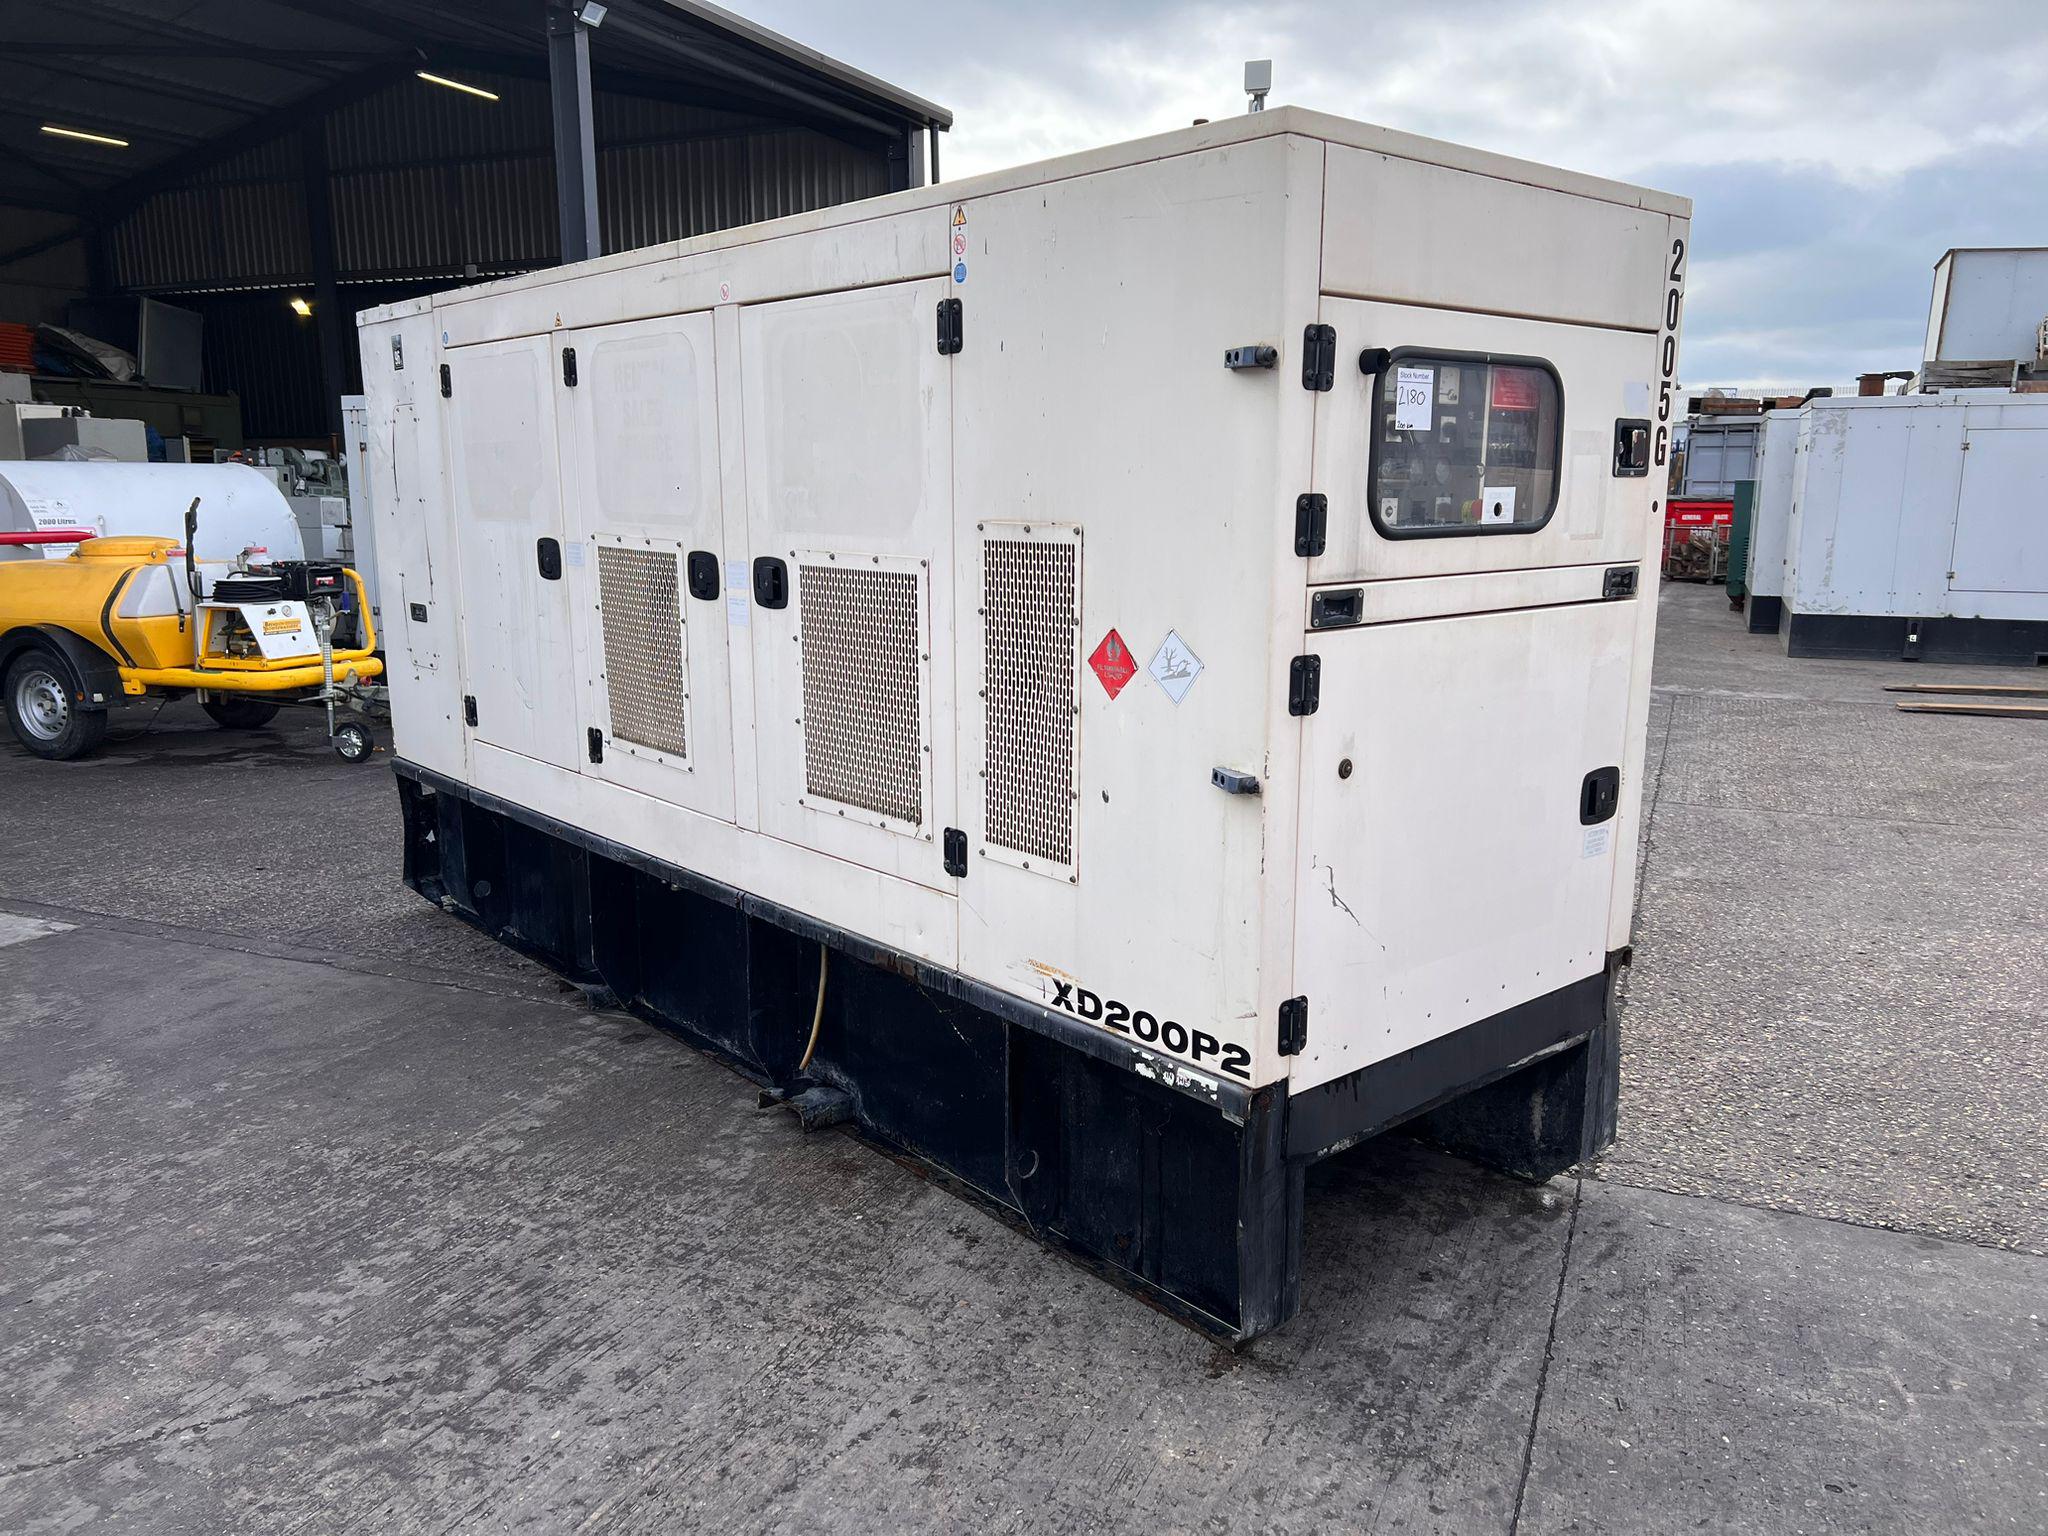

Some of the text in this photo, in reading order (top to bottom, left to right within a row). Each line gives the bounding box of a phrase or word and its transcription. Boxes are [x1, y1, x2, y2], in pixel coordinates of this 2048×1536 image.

[1400, 371, 1430, 380] Stock Number
[1655, 238, 1685, 467] 2005G
[1398, 386, 1426, 405] 2180
[1051, 978, 1251, 1080] XD200P2
